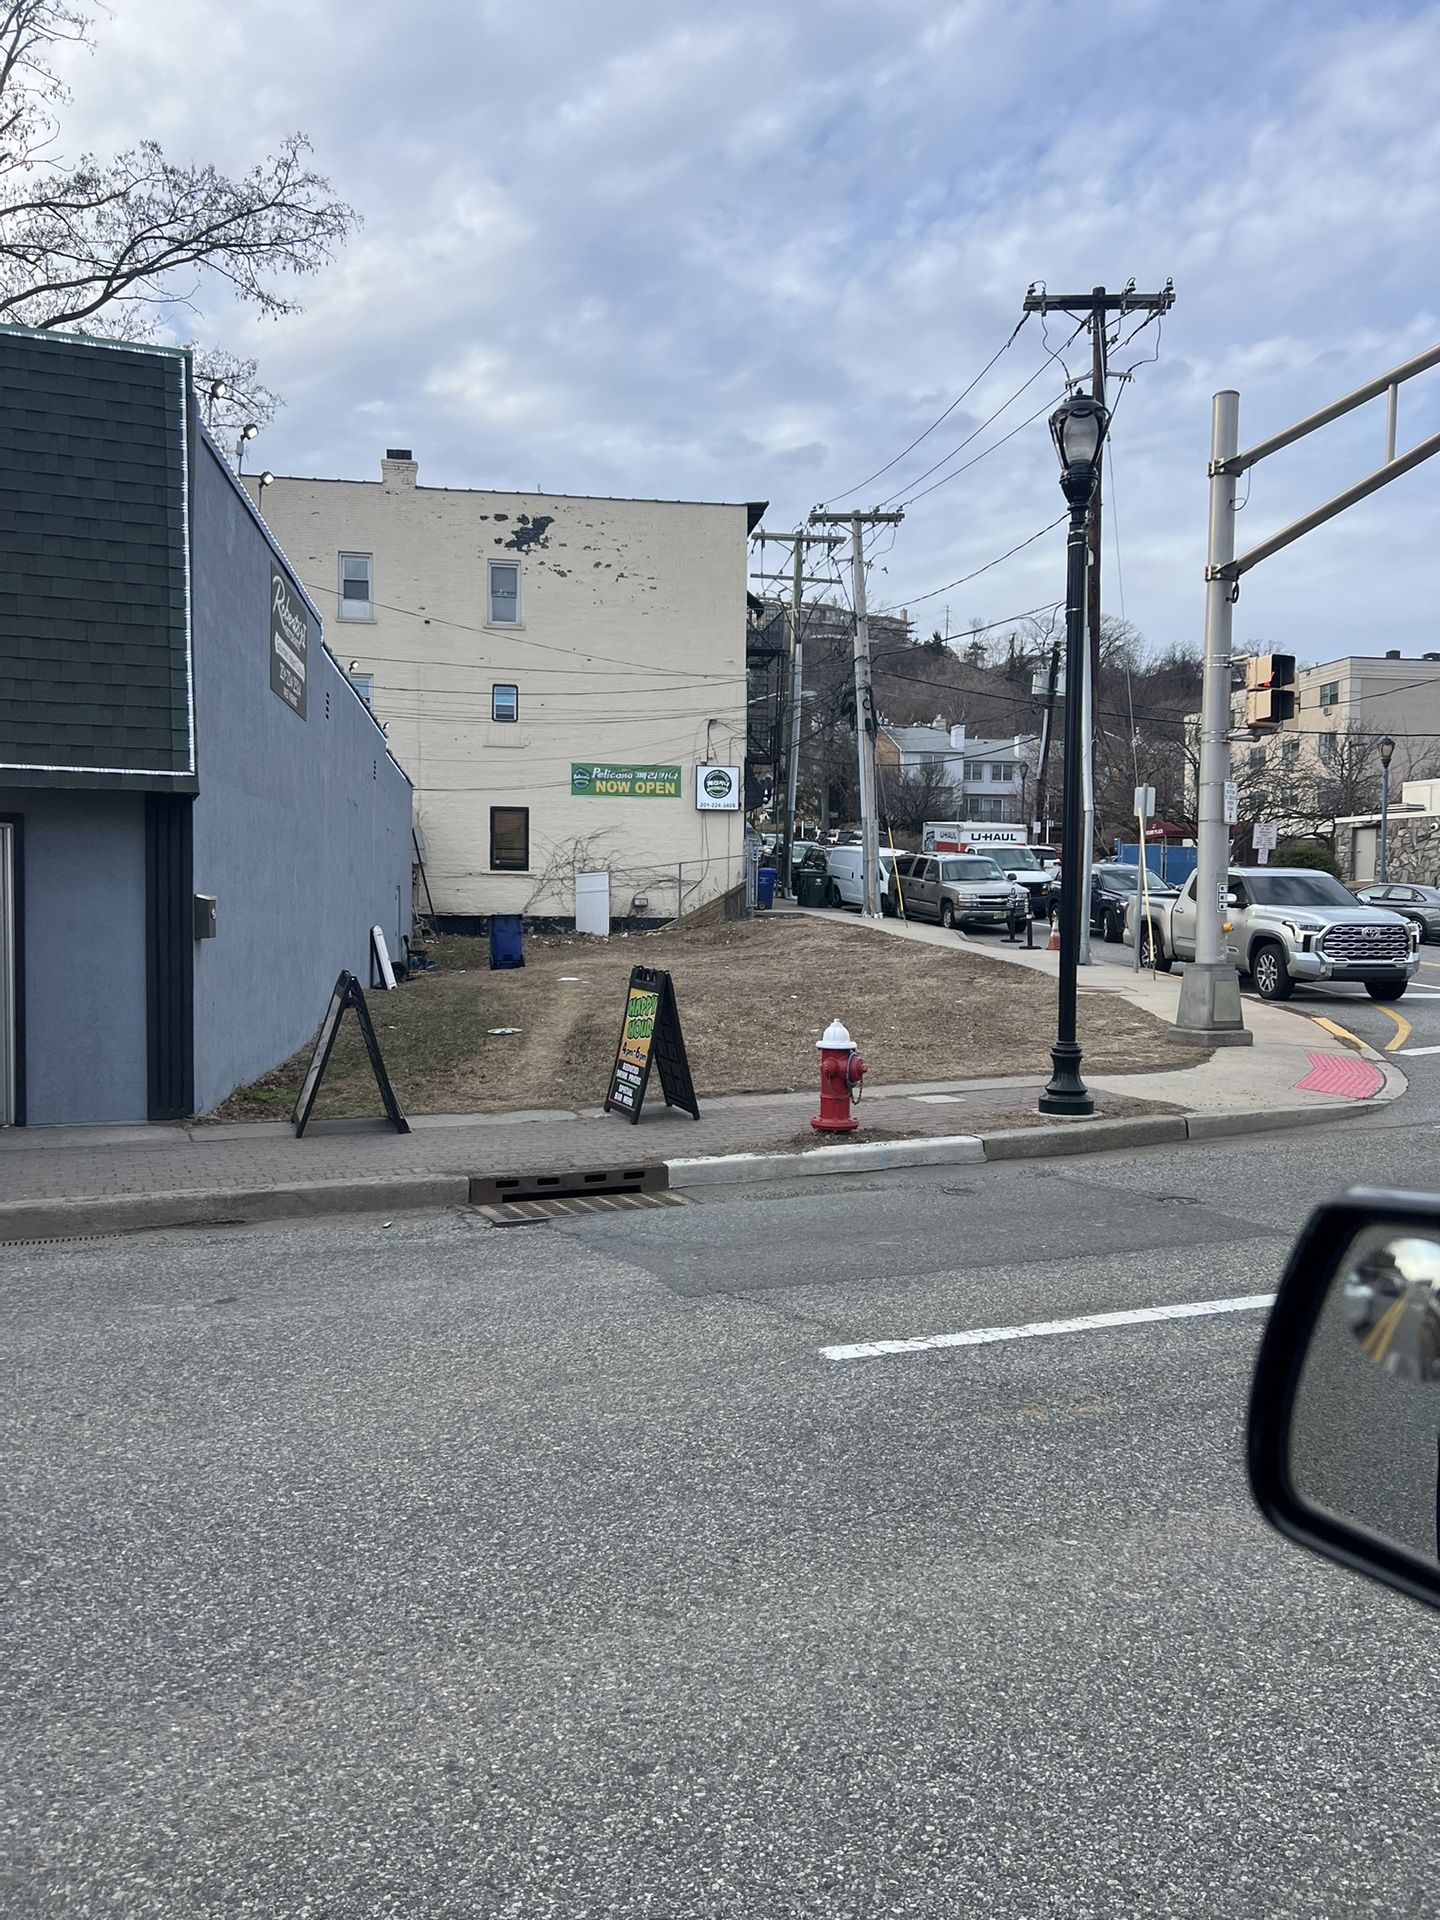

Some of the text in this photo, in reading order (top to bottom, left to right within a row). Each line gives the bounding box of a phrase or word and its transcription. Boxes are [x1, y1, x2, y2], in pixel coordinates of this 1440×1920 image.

[596, 781, 630, 793] NOW
[635, 782, 676, 794] OPEN
[940, 831, 957, 840] U-HAUL
[971, 833, 1017, 841] U-HAUL
[628, 995, 658, 1017] HAPPY
